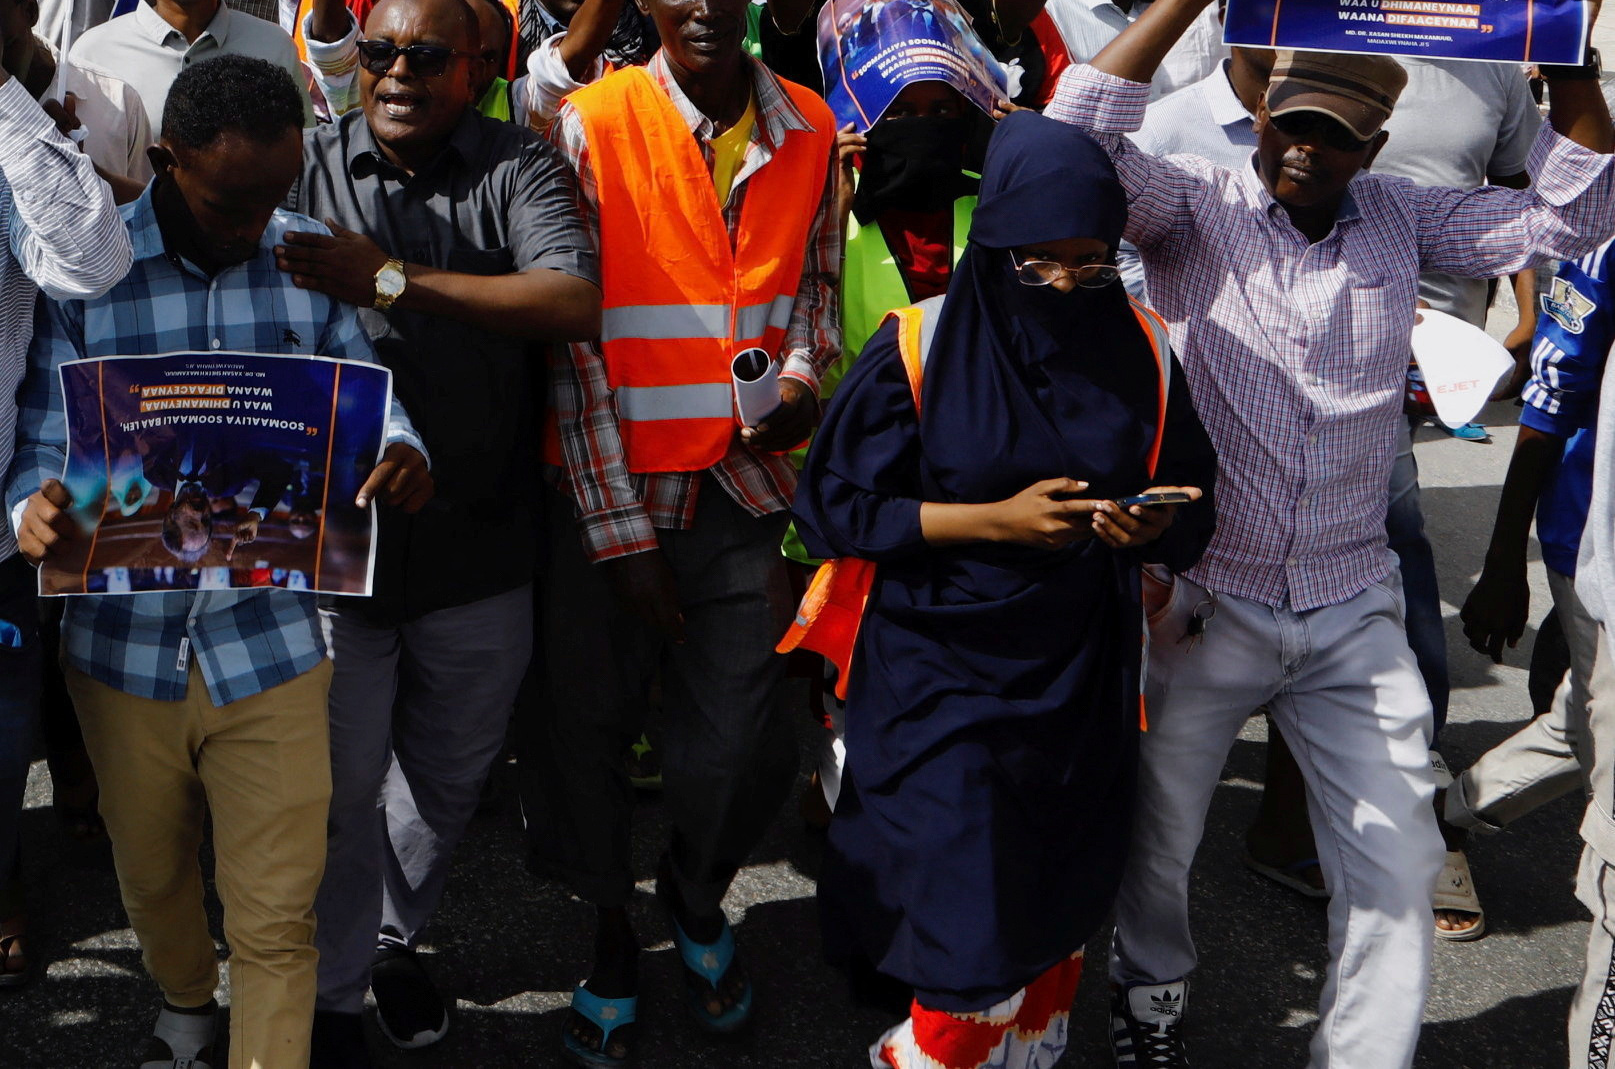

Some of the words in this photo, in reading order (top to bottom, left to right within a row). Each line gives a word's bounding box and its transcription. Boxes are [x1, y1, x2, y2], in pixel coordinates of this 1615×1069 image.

[1371, 0, 1379, 8] U
[1381, 0, 1479, 15] DHIMANEYNAA,
[1338, 11, 1385, 22] WAANA
[1387, 14, 1478, 28] DIFAACEYNAA
[142, 385, 225, 397] DIFAACEYNAA
[227, 386, 273, 396] WAANA
[1436, 379, 1480, 395] EJET
[141, 399, 230, 412] DHIMANEYNAA,
[232, 400, 241, 409] U
[244, 401, 273, 411] WAA
[119, 420, 140, 432] LEH,
[141, 416, 162, 429] BAA
[163, 415, 223, 425] SOOMAALI
[227, 415, 305, 431] SOOMAALIYA
